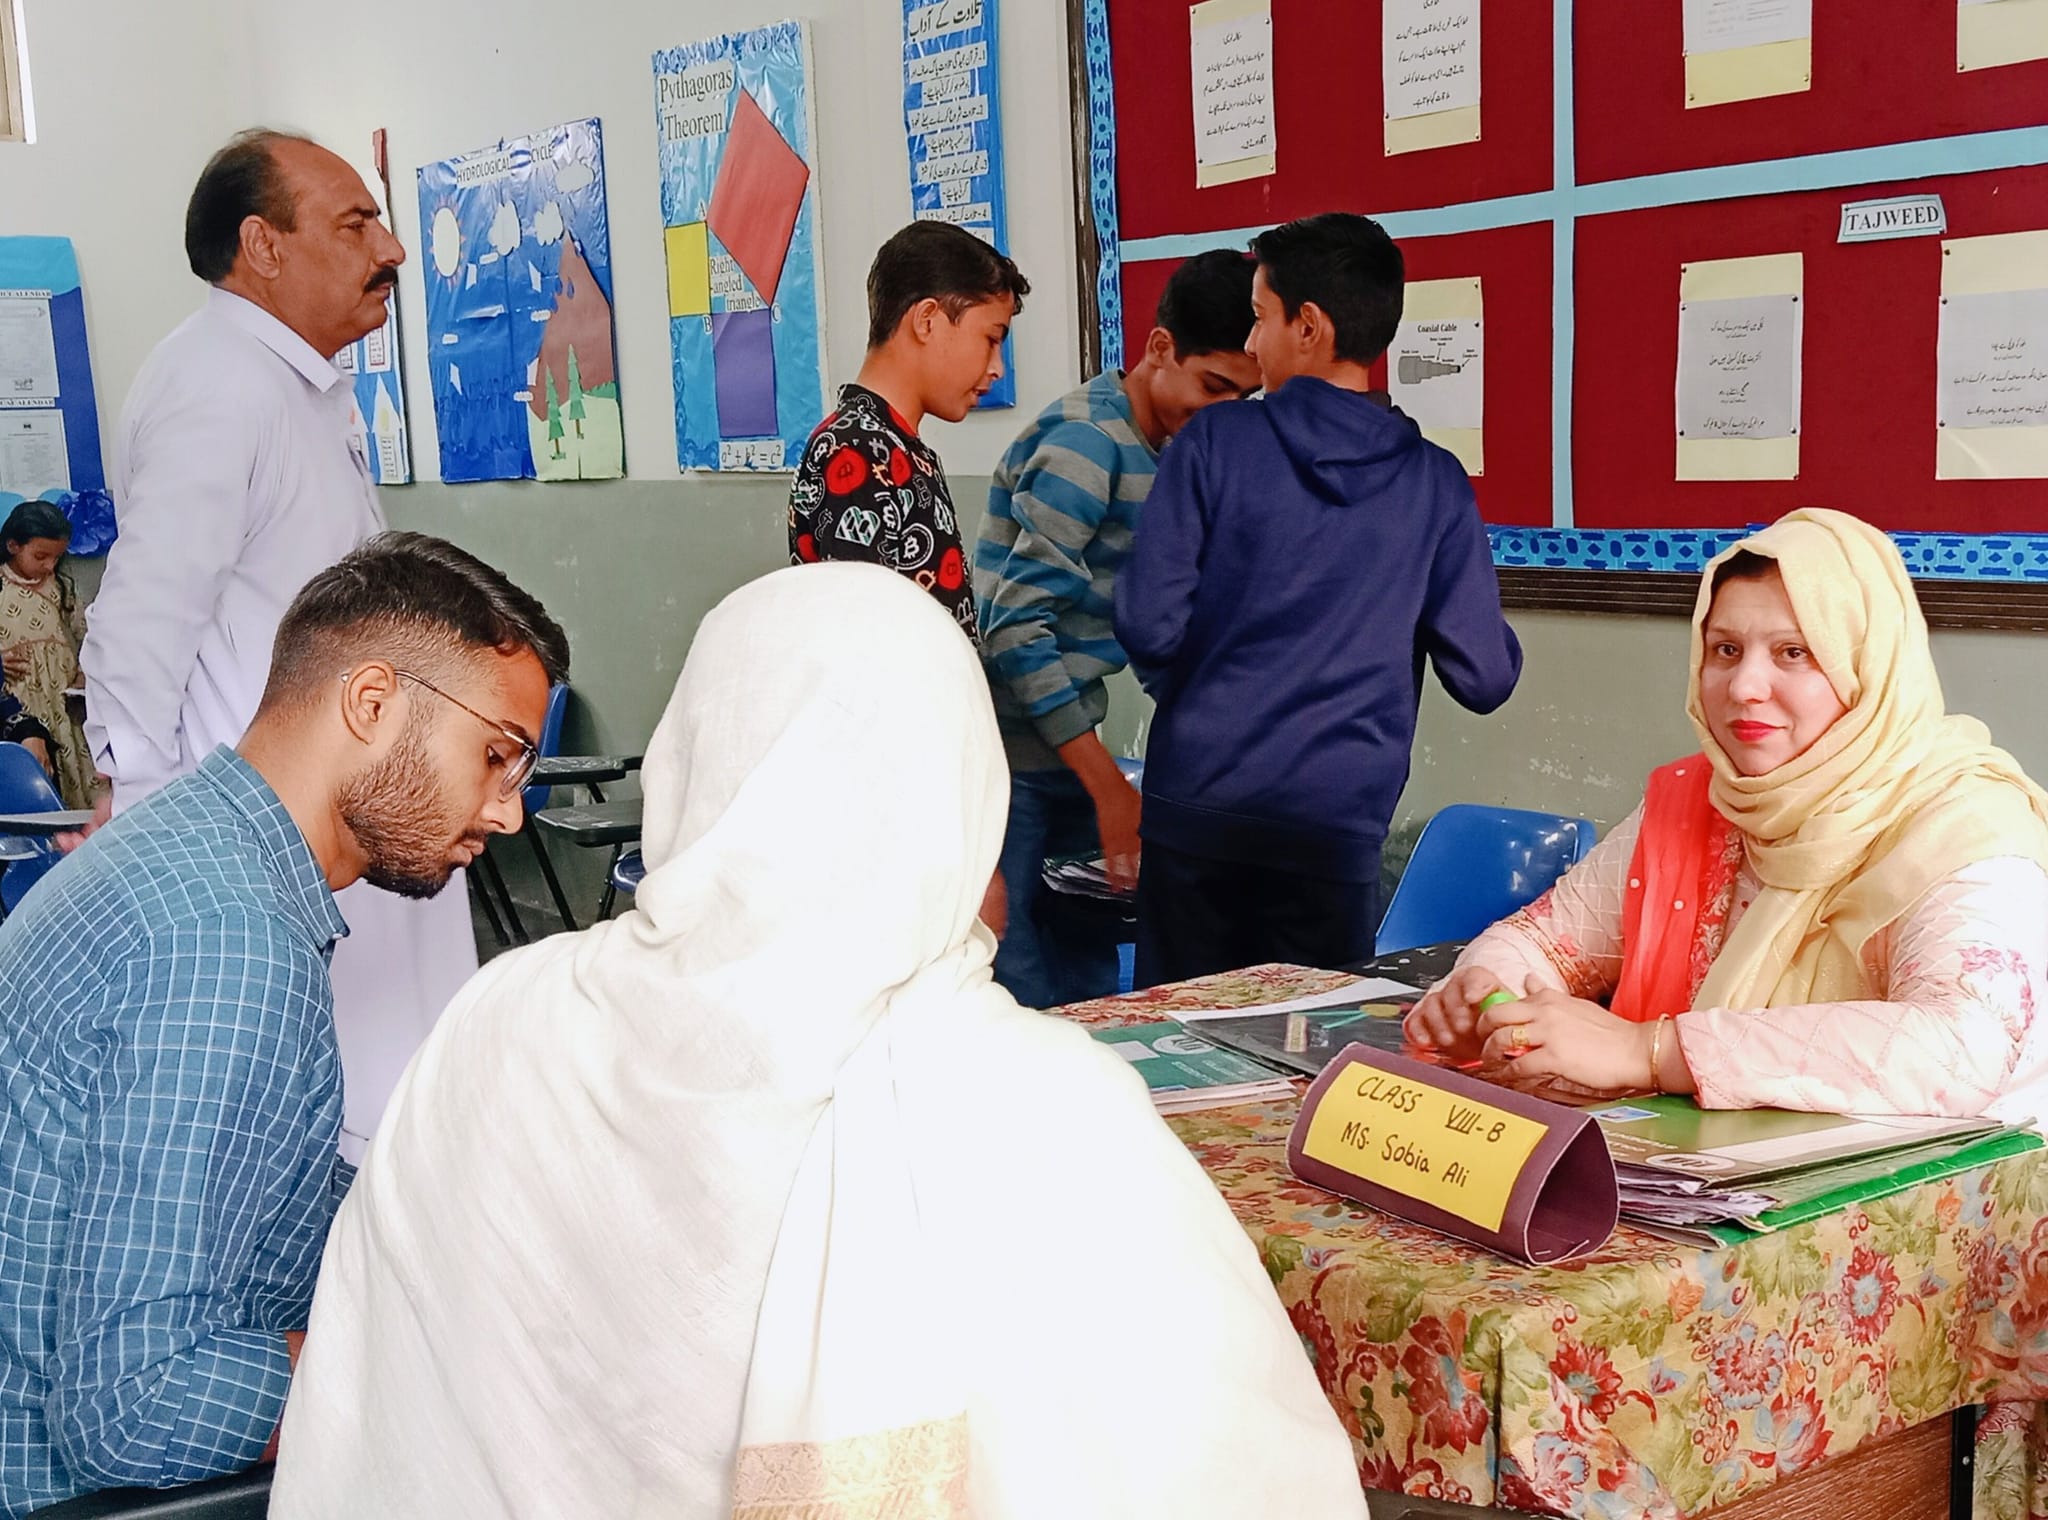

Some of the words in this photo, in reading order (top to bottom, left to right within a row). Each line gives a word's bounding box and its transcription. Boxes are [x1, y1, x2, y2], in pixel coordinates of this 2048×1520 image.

[909, 7, 934, 42] آداب
[935, 0, 950, 29] کے
[660, 69, 733, 108] Pythagoras
[664, 112, 724, 141] Theorem
[457, 157, 510, 183] HYDROLOGICAL
[531, 144, 553, 163] CYCLE
[698, 201, 706, 216] A
[1847, 206, 1939, 231] TAJWEED
[711, 258, 733, 275] Right
[704, 316, 712, 332] B
[772, 305, 781, 322] C
[1357, 1076, 1423, 1113] CLASS
[1381, 1134, 1430, 1173] Sobia
[1442, 1161, 1470, 1188] Ali
